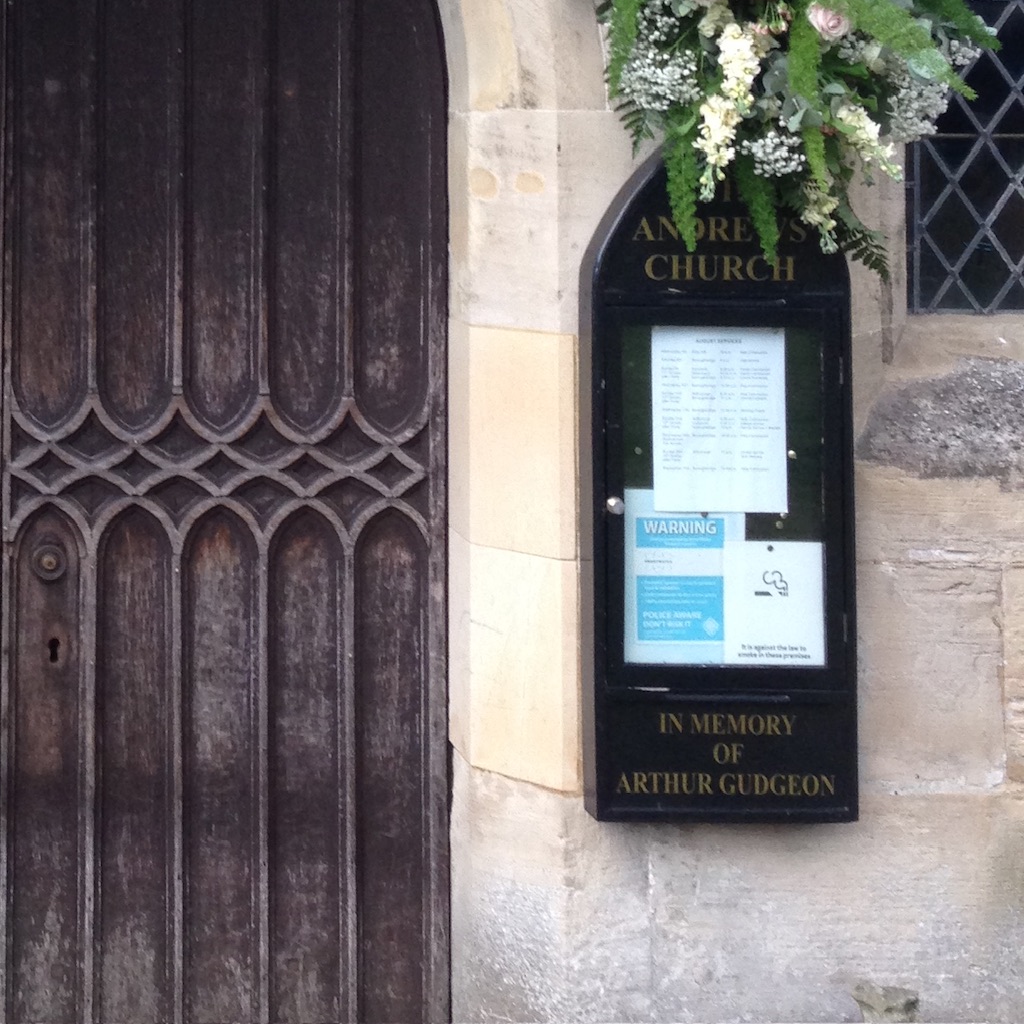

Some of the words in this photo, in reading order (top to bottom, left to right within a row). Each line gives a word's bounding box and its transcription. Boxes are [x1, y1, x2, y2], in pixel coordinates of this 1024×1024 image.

[644, 254, 795, 282] CHURCH
[644, 520, 717, 535] WARNING
[754, 644, 776, 653] against
[660, 713, 683, 734] IN
[691, 714, 796, 736] MEMORY
[713, 743, 744, 764] OF
[616, 772, 713, 795] ARTHUR
[719, 774, 835, 796] GUDGEON
